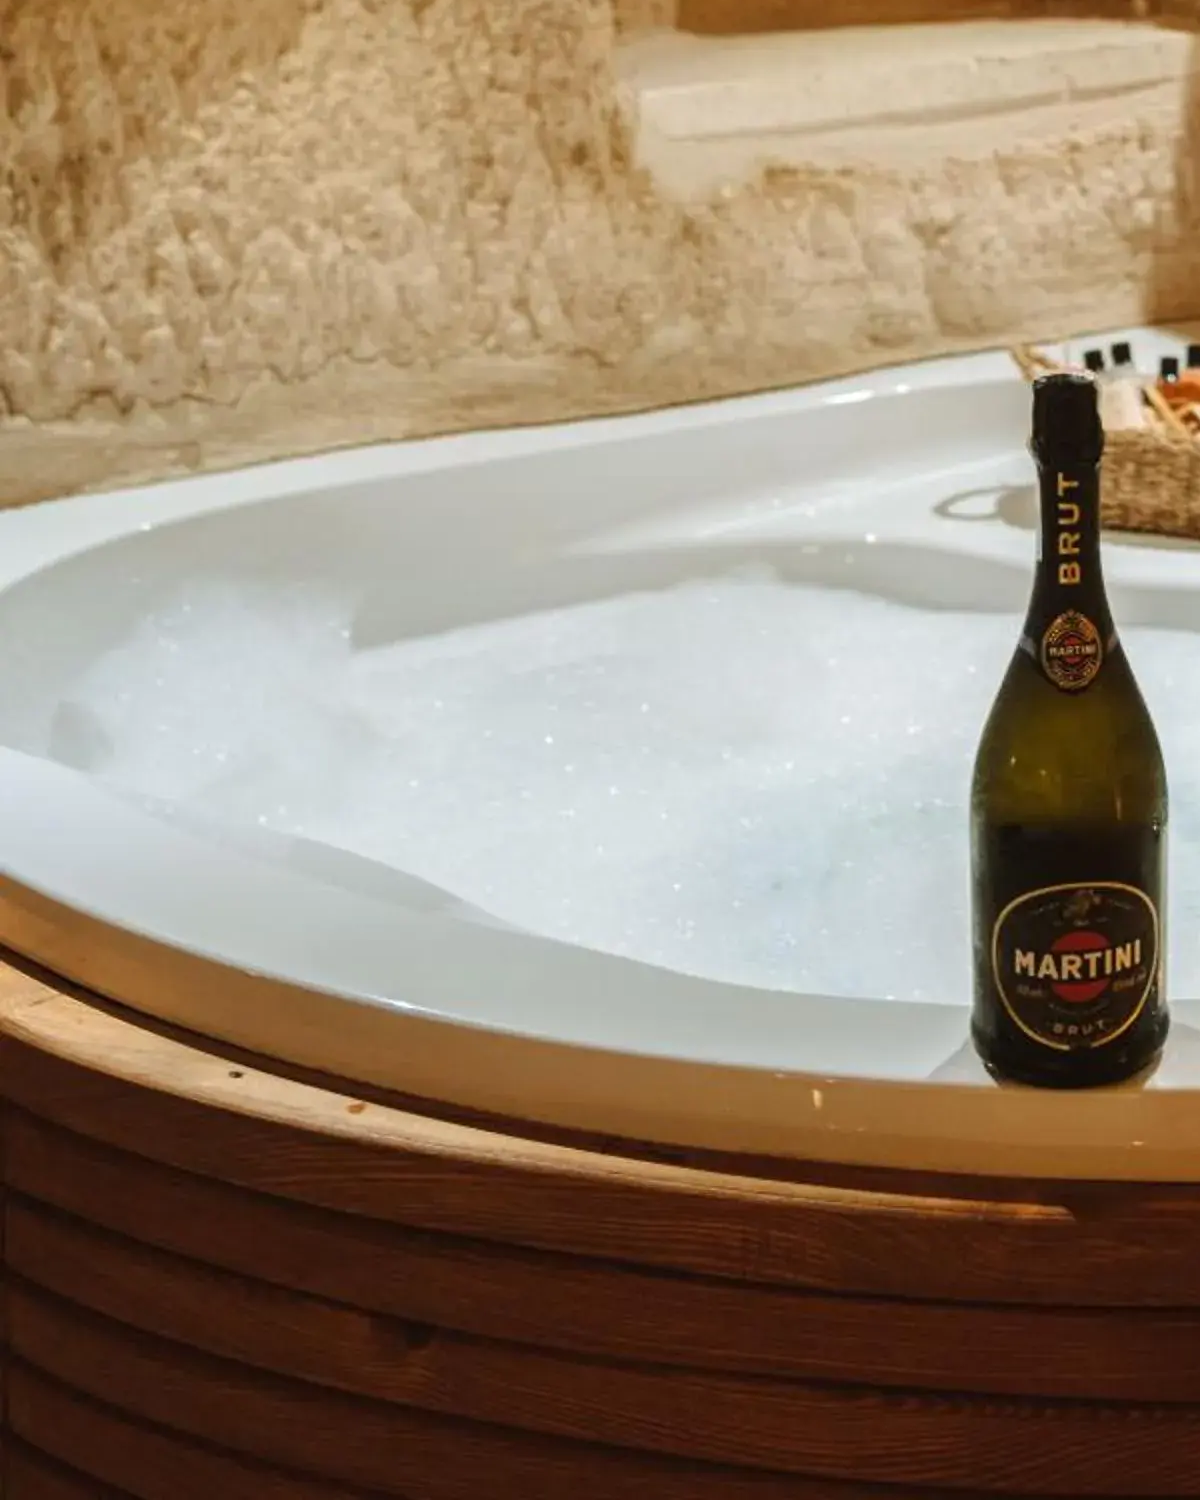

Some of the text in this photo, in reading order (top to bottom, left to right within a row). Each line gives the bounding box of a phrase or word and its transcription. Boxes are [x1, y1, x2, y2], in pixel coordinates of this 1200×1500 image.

[1057, 472, 1081, 584] BRUT
[1014, 939, 1141, 981] MARTINI
[1052, 1019, 1106, 1035] BRUT
